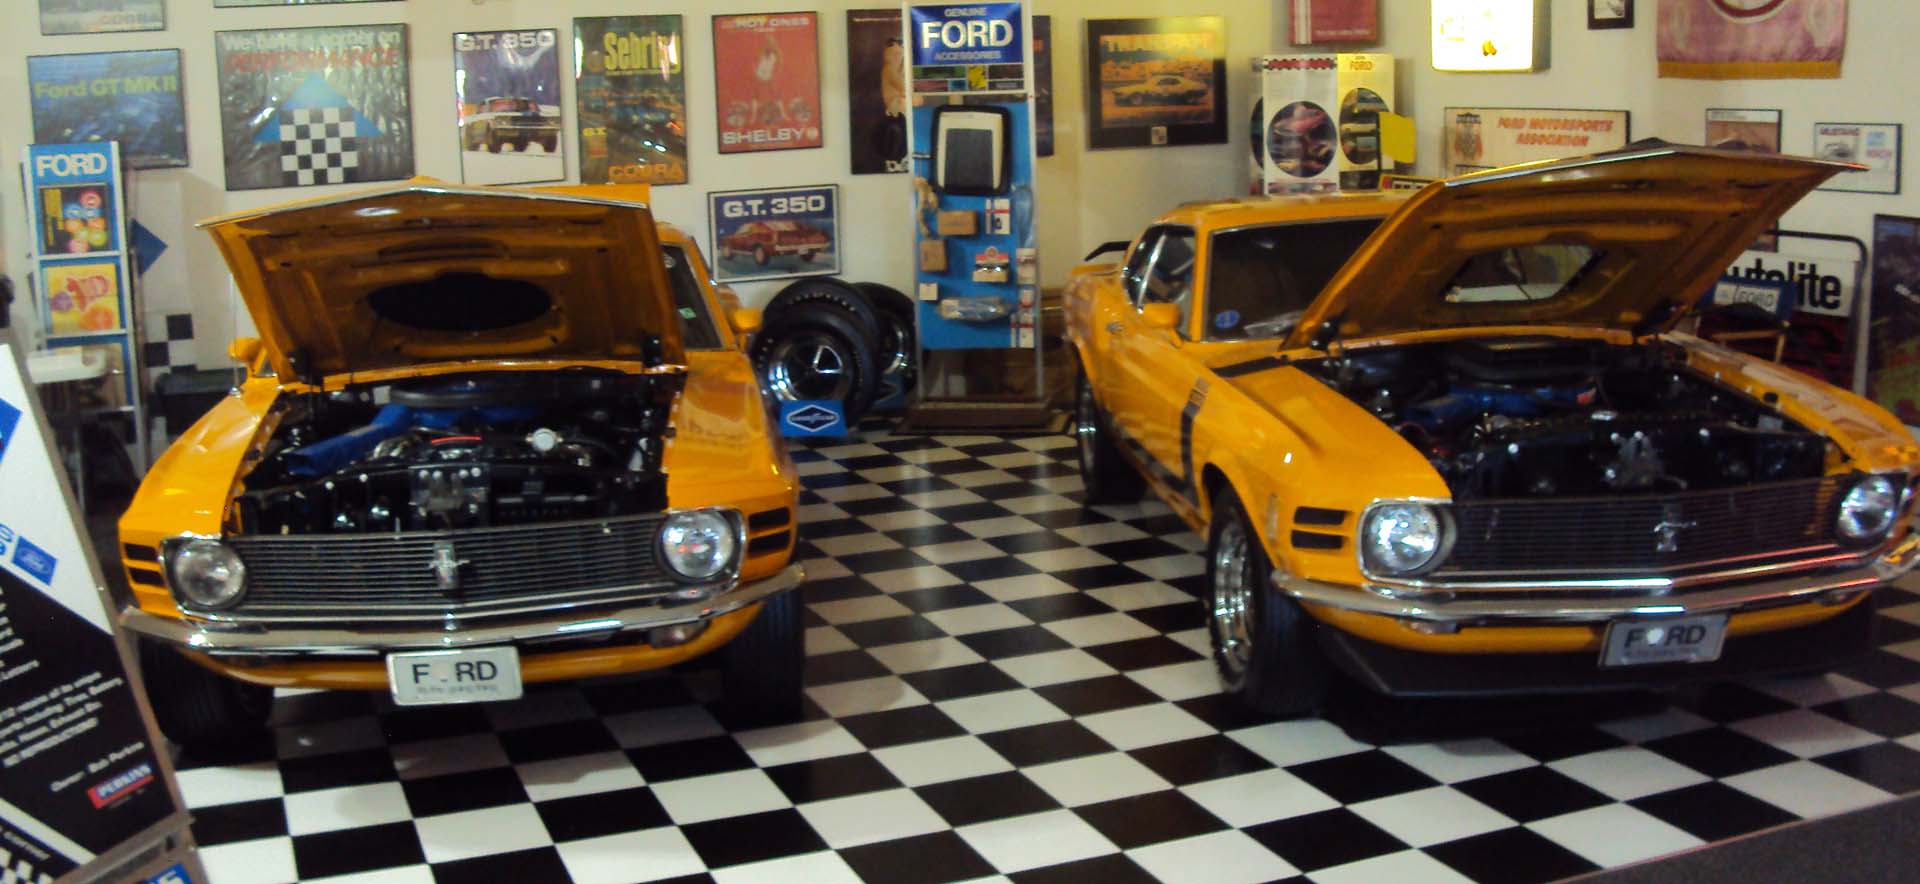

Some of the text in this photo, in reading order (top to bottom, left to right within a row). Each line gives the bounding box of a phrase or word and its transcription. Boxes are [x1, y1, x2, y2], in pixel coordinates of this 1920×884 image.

[944, 7, 987, 17] GENUINE
[920, 19, 1014, 49] FORD
[223, 48, 399, 74] PERFORMANCE
[933, 50, 1002, 62] ACCESSORIES
[1350, 60, 1373, 71] FORD
[34, 80, 88, 99] Ford
[92, 77, 121, 97] GT
[1498, 117, 1614, 132] FORD MOTORSPORTS
[722, 128, 806, 145] SHELBY
[1515, 133, 1590, 147] ASSOCIATION
[37, 152, 108, 177] FORD
[607, 163, 685, 180] COBRA
[723, 195, 826, 218] G.T. 350
[1624, 624, 1707, 649] FRD
[411, 660, 498, 684] FRD
